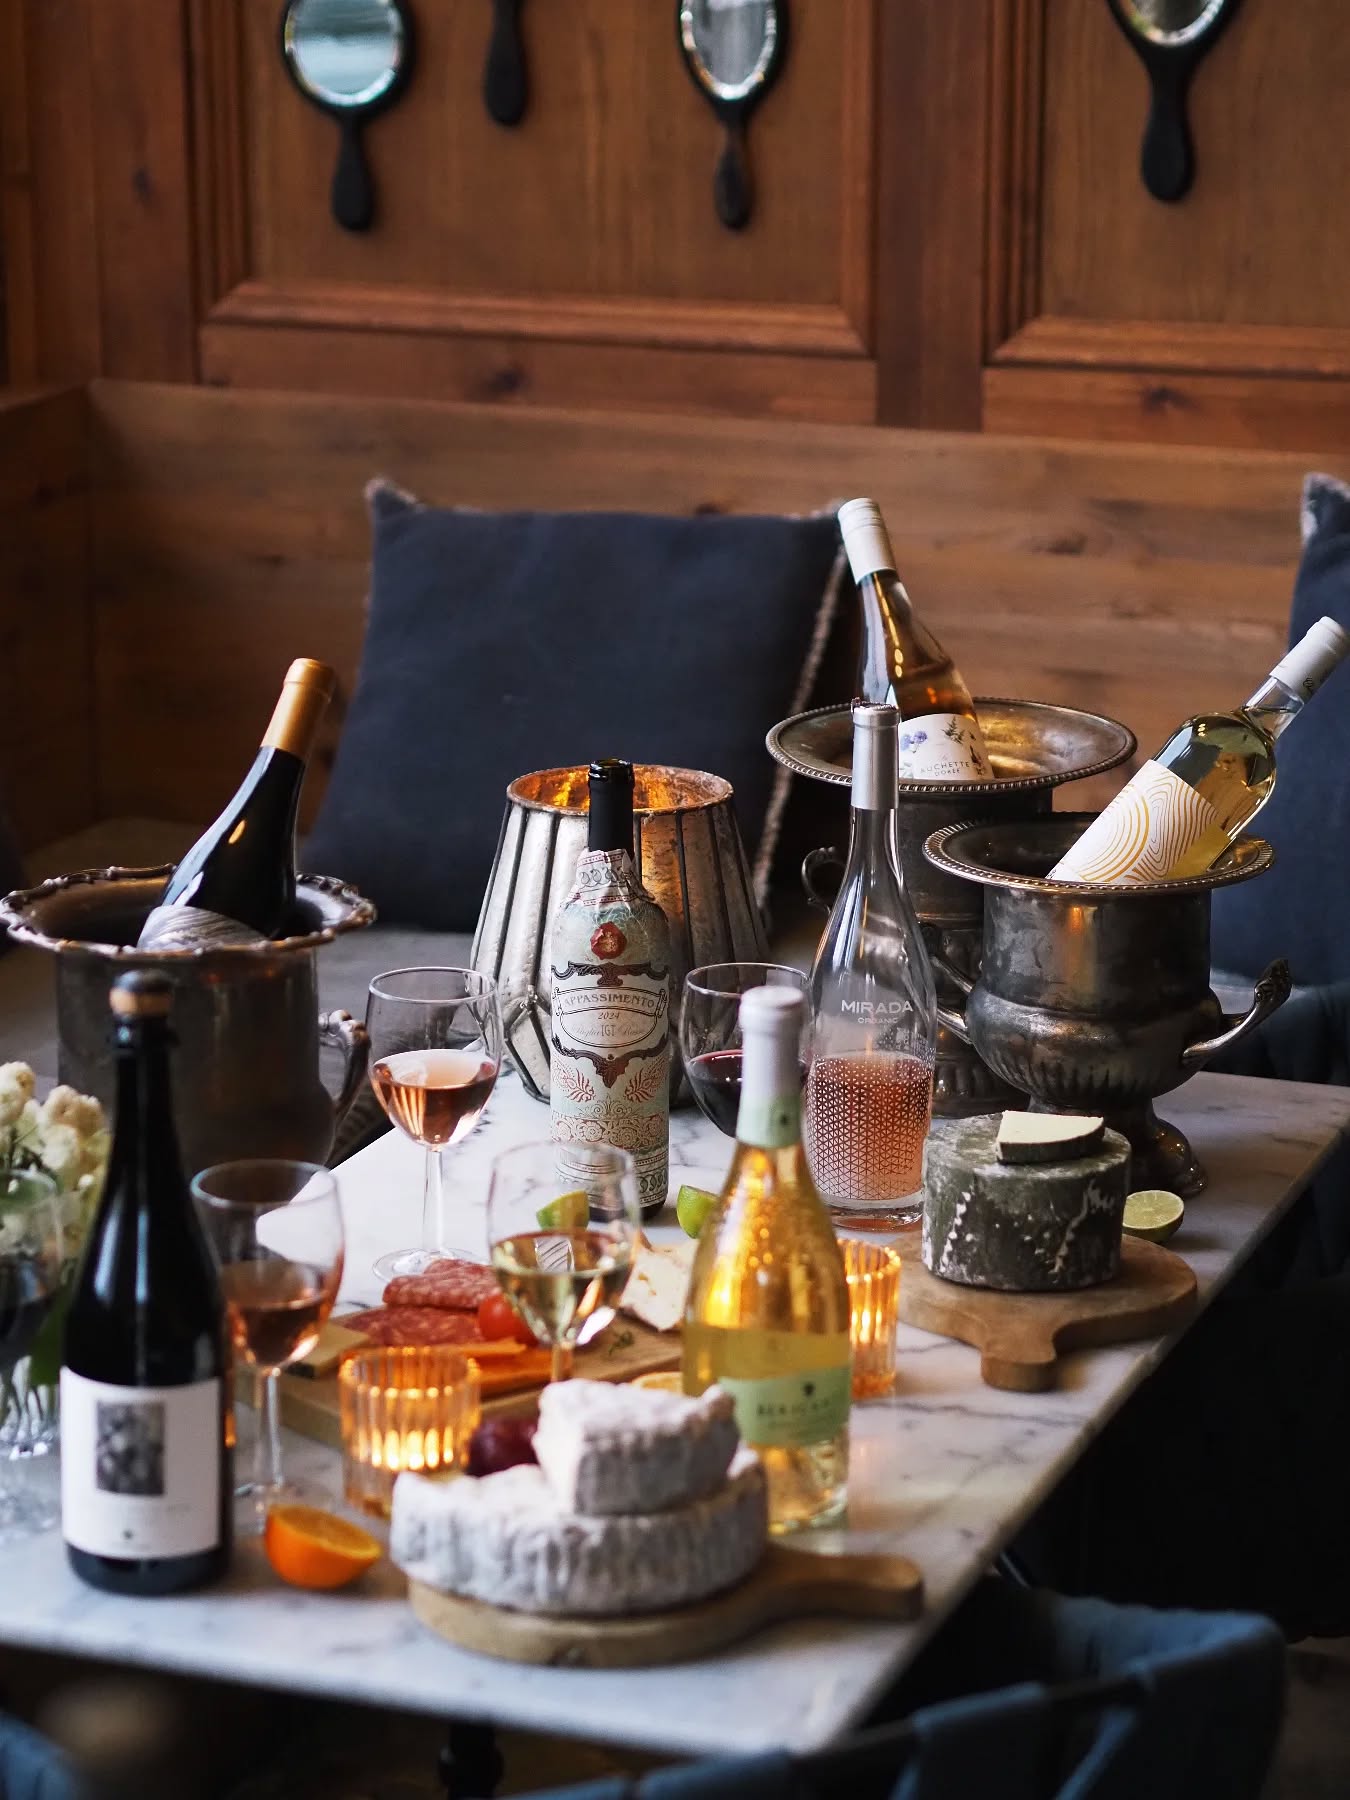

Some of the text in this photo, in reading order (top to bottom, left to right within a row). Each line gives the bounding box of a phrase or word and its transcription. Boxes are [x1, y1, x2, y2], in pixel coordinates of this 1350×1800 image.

[564, 993, 655, 1008] APPASSIMENTO
[841, 1000, 914, 1013] MIRADA
[597, 1011, 620, 1020] 2024
[601, 1024, 616, 1037] IGT
